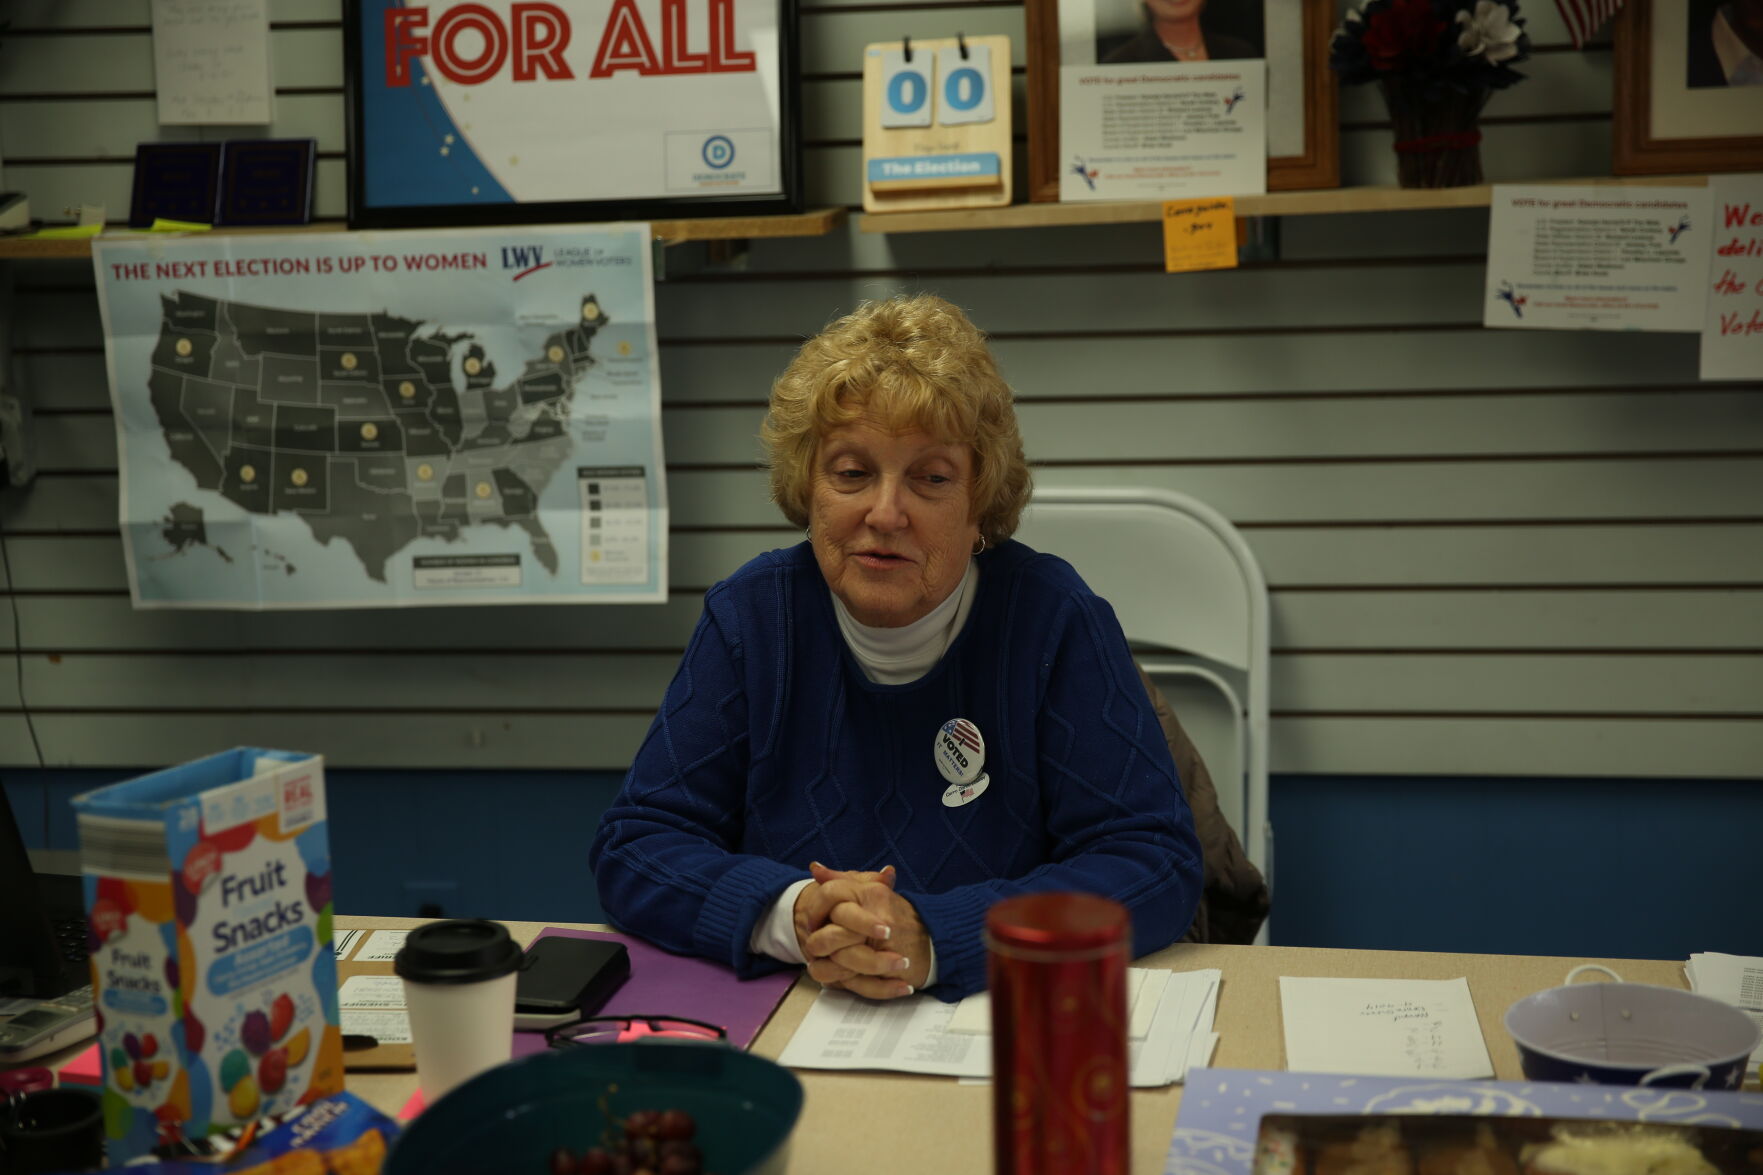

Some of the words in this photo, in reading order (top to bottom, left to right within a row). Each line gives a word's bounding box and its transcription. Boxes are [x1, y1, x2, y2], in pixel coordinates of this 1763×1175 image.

[384, 2, 575, 87] FOR
[589, 0, 756, 79] ALL
[887, 70, 927, 114] 0
[945, 67, 984, 111] 0
[881, 162, 912, 175] The
[914, 159, 981, 174] Election
[112, 263, 149, 280] THE
[155, 260, 207, 279] NEXT
[213, 258, 310, 277] ELECTION
[316, 256, 333, 274] IS
[339, 256, 365, 273] UP
[371, 254, 398, 272] TO
[403, 252, 487, 272] WOMEN
[502, 246, 543, 269] LWV
[1713, 269, 1747, 296] the
[943, 733, 969, 768] VOTED
[221, 859, 287, 908] Fruit
[213, 900, 303, 954] Snacks
[111, 947, 152, 970] Fruit
[107, 968, 161, 993] Snacks
